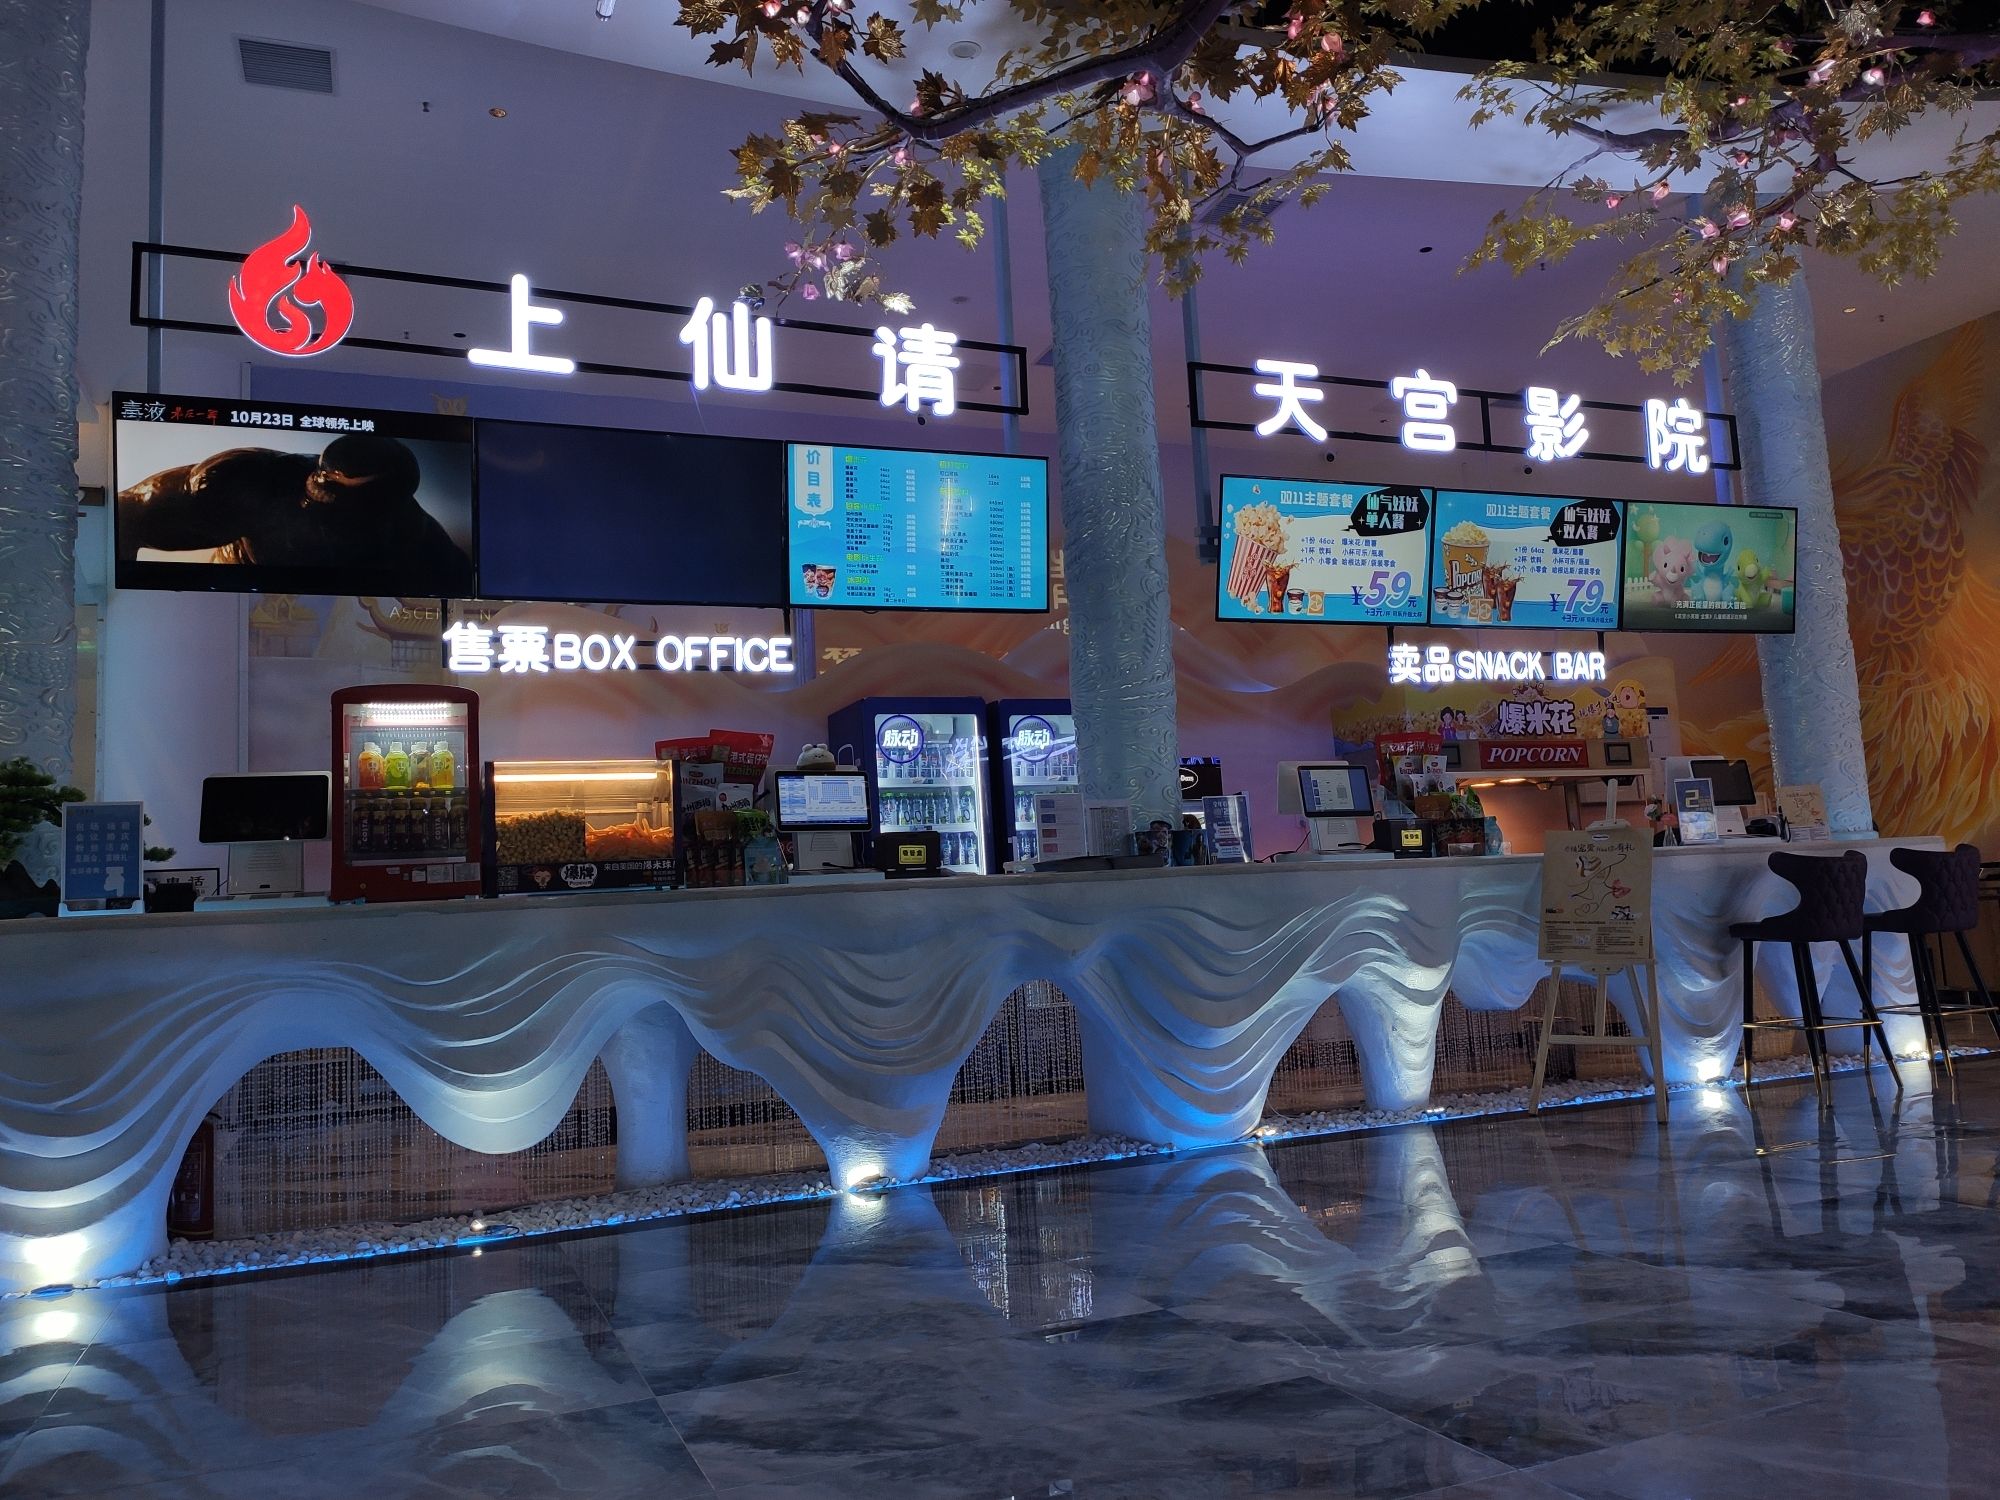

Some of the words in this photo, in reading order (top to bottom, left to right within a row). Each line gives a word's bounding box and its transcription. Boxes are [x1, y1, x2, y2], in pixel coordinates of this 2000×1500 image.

[230, 410, 294, 427] 10月23日
[299, 415, 375, 432] 全球领先上映
[1253, 358, 1709, 474] 天宫影院
[806, 449, 821, 508] 价目表
[1366, 511, 1405, 529] 单人餐
[1318, 537, 1335, 545] 46oz
[1563, 524, 1599, 540] 双人餐
[1300, 546, 1315, 555] +1杯
[1318, 547, 1332, 555] 饮料
[1318, 557, 1338, 566] 小零食
[1530, 556, 1542, 564] 饮料
[1513, 565, 1527, 573] +2个
[1529, 566, 1548, 574] 小零食
[442, 621, 550, 673] 售票
[553, 633, 636, 672] BOX
[656, 634, 794, 673] OFFICE
[1388, 643, 1455, 684] 卖品
[1455, 650, 1546, 681] SNACK
[1553, 651, 1607, 681] BAR
[1498, 699, 1577, 736] 爆米花
[882, 728, 920, 751] 脉动
[1016, 729, 1051, 750] 脉动
[1487, 747, 1583, 763] POPCORN
[564, 865, 596, 881] 爆牌
